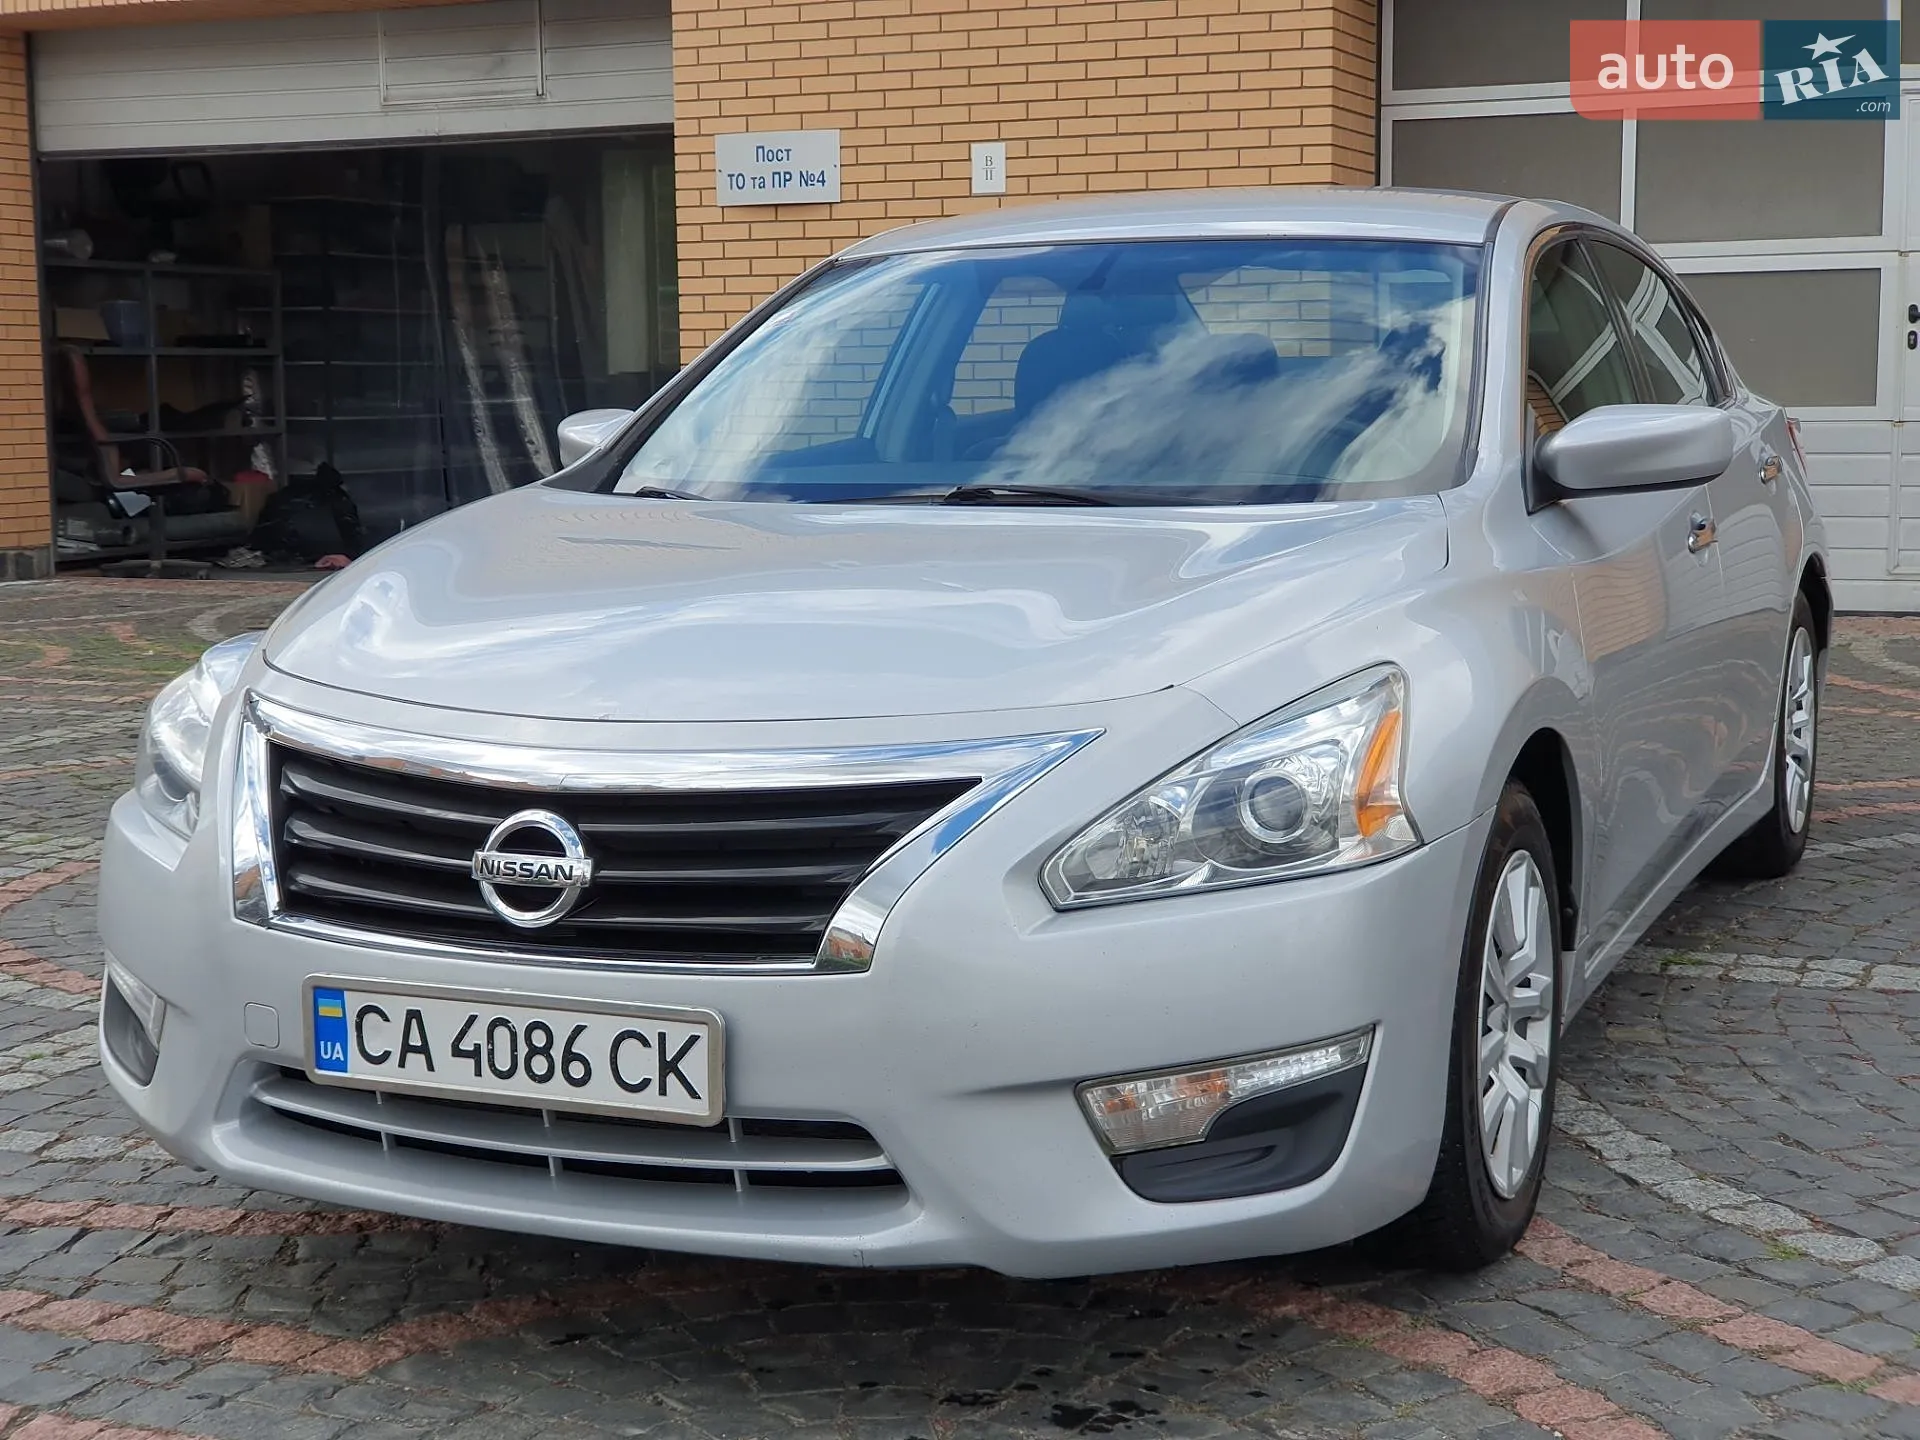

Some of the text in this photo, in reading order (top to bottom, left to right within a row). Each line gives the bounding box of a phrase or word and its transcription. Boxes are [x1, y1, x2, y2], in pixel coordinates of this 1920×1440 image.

[755, 145, 792, 163] Пост
[727, 170, 826, 191] ТО та ПР №4
[479, 858, 574, 881] NISSAN
[319, 1040, 345, 1062] UA
[354, 1004, 702, 1100] CA 4086 CK
